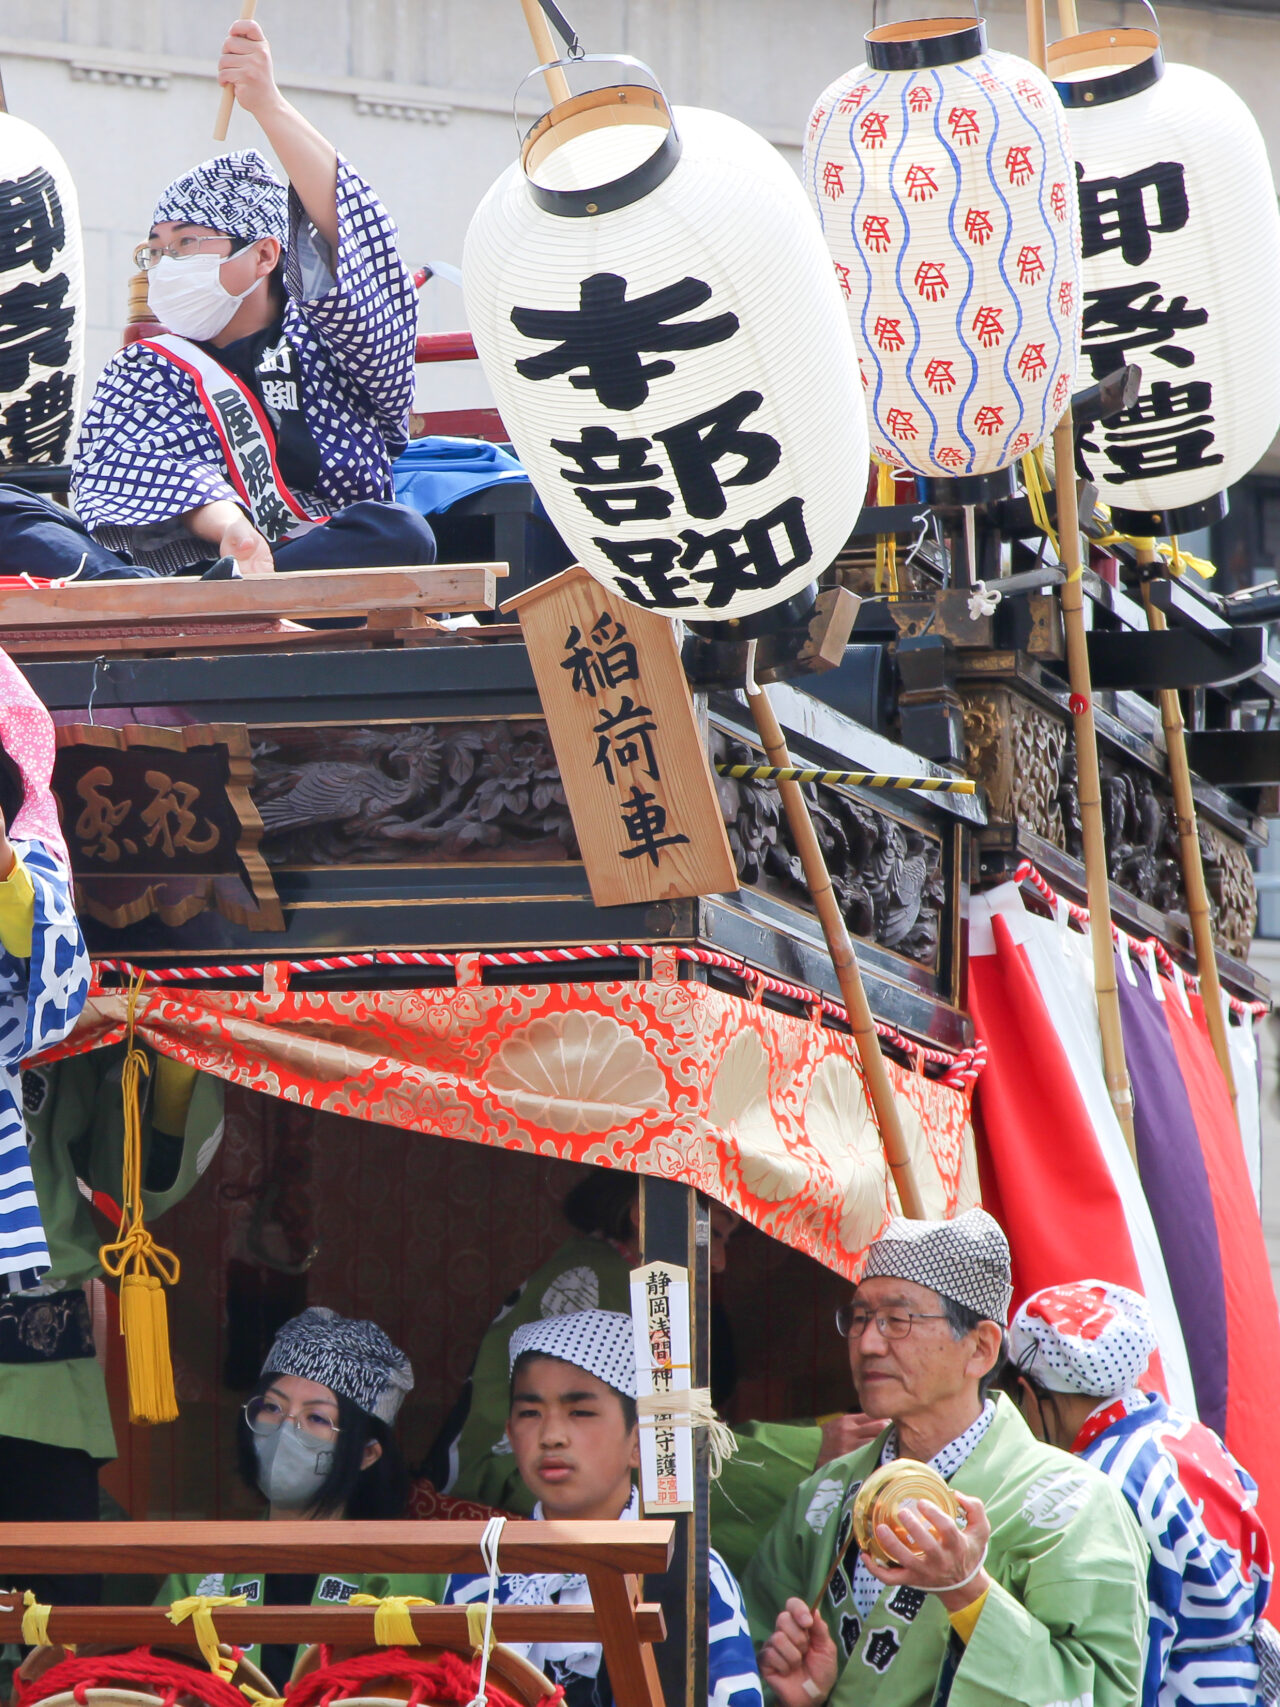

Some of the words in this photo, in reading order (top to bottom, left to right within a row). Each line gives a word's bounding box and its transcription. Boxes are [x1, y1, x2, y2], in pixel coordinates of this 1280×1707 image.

[909, 87, 932, 112] 祭
[861, 112, 889, 149] 祭
[948, 108, 980, 146] 祭
[824, 162, 844, 200] 祭
[905, 164, 938, 202] 祭
[1005, 146, 1034, 186] 祭
[863, 215, 891, 253] 祭
[965, 208, 993, 246] 祭
[914, 261, 949, 302] 祭
[1017, 246, 1045, 286] 祭
[874, 316, 905, 352] 祭
[972, 306, 1004, 348] 祭
[925, 358, 956, 395] 祭
[1019, 344, 1047, 382] 祭
[886, 408, 919, 440] 祭
[975, 406, 1004, 436] 祭
[936, 448, 967, 468] 祭
[560, 611, 690, 868] 稲荷車
[646, 1270, 677, 1477] 静岡浅間神守護
